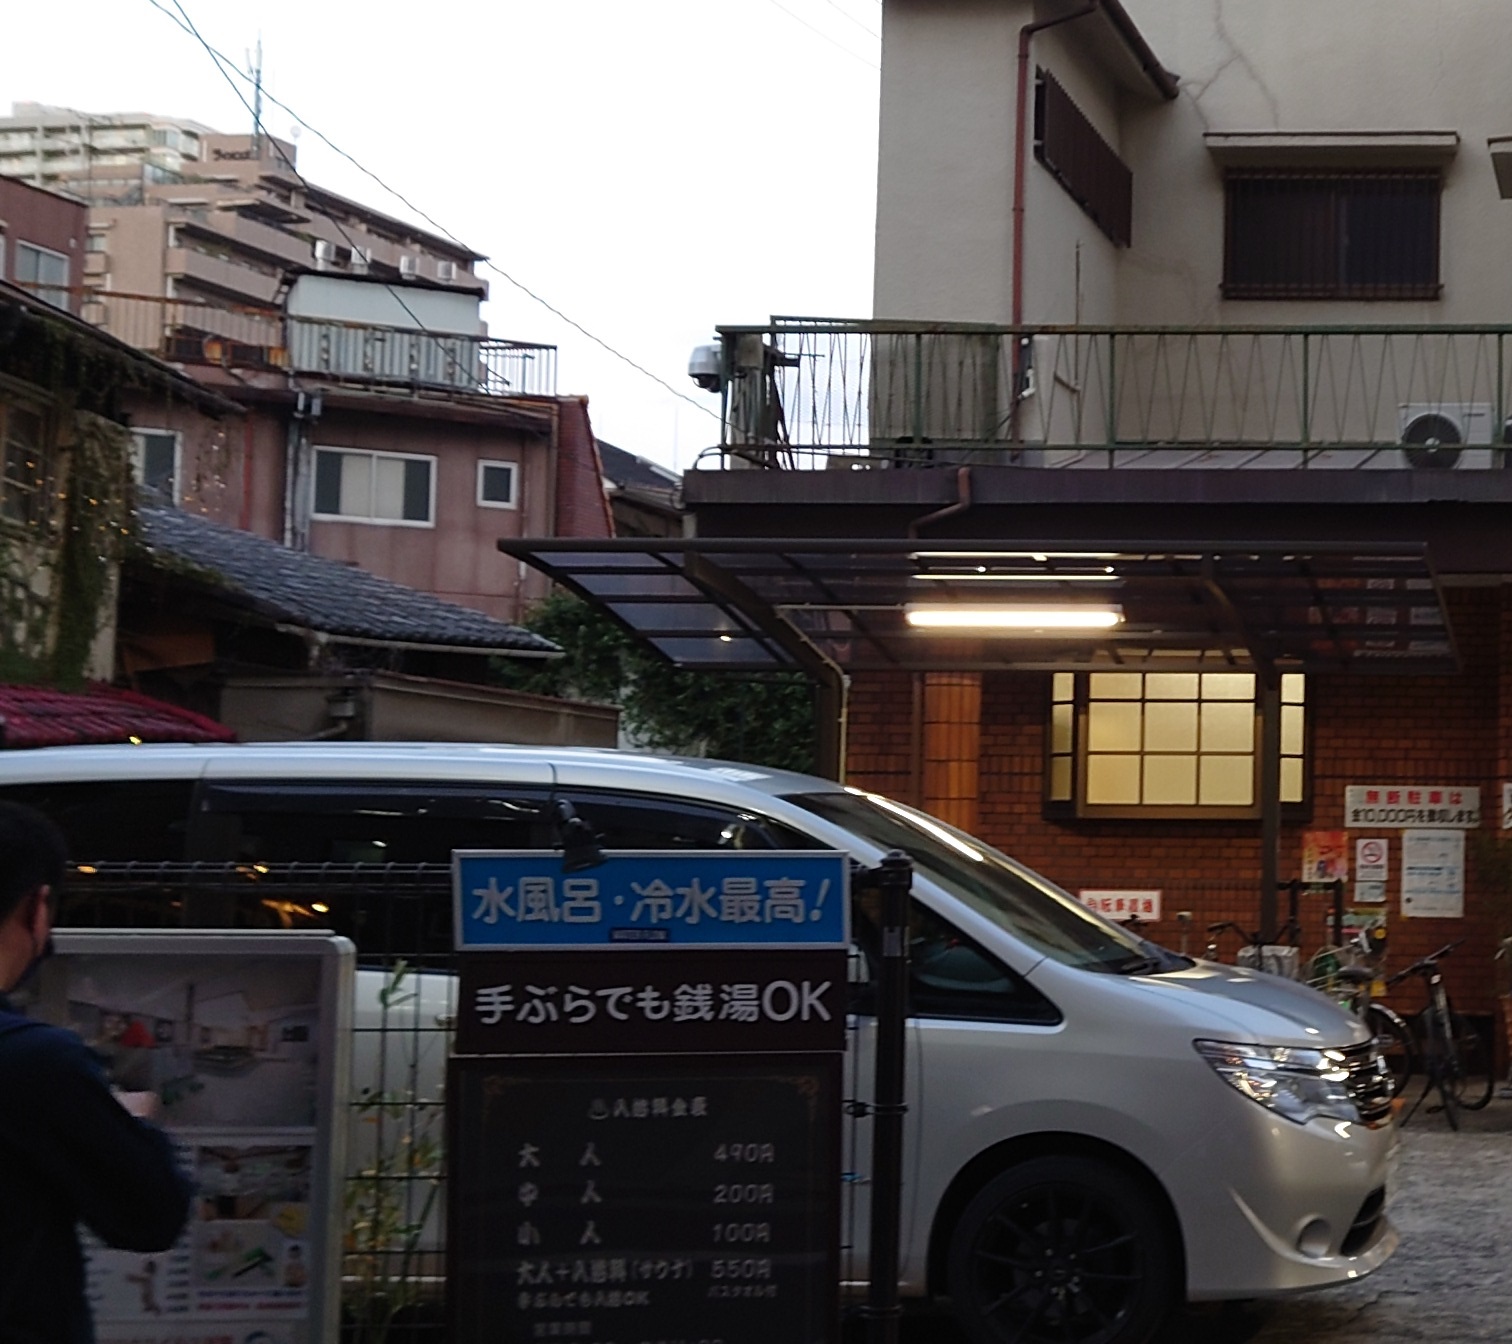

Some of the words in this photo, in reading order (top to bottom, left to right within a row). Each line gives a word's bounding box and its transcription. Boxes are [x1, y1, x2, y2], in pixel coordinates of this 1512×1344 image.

[474, 979, 833, 1024] 手ぶらでも銭湯OK
